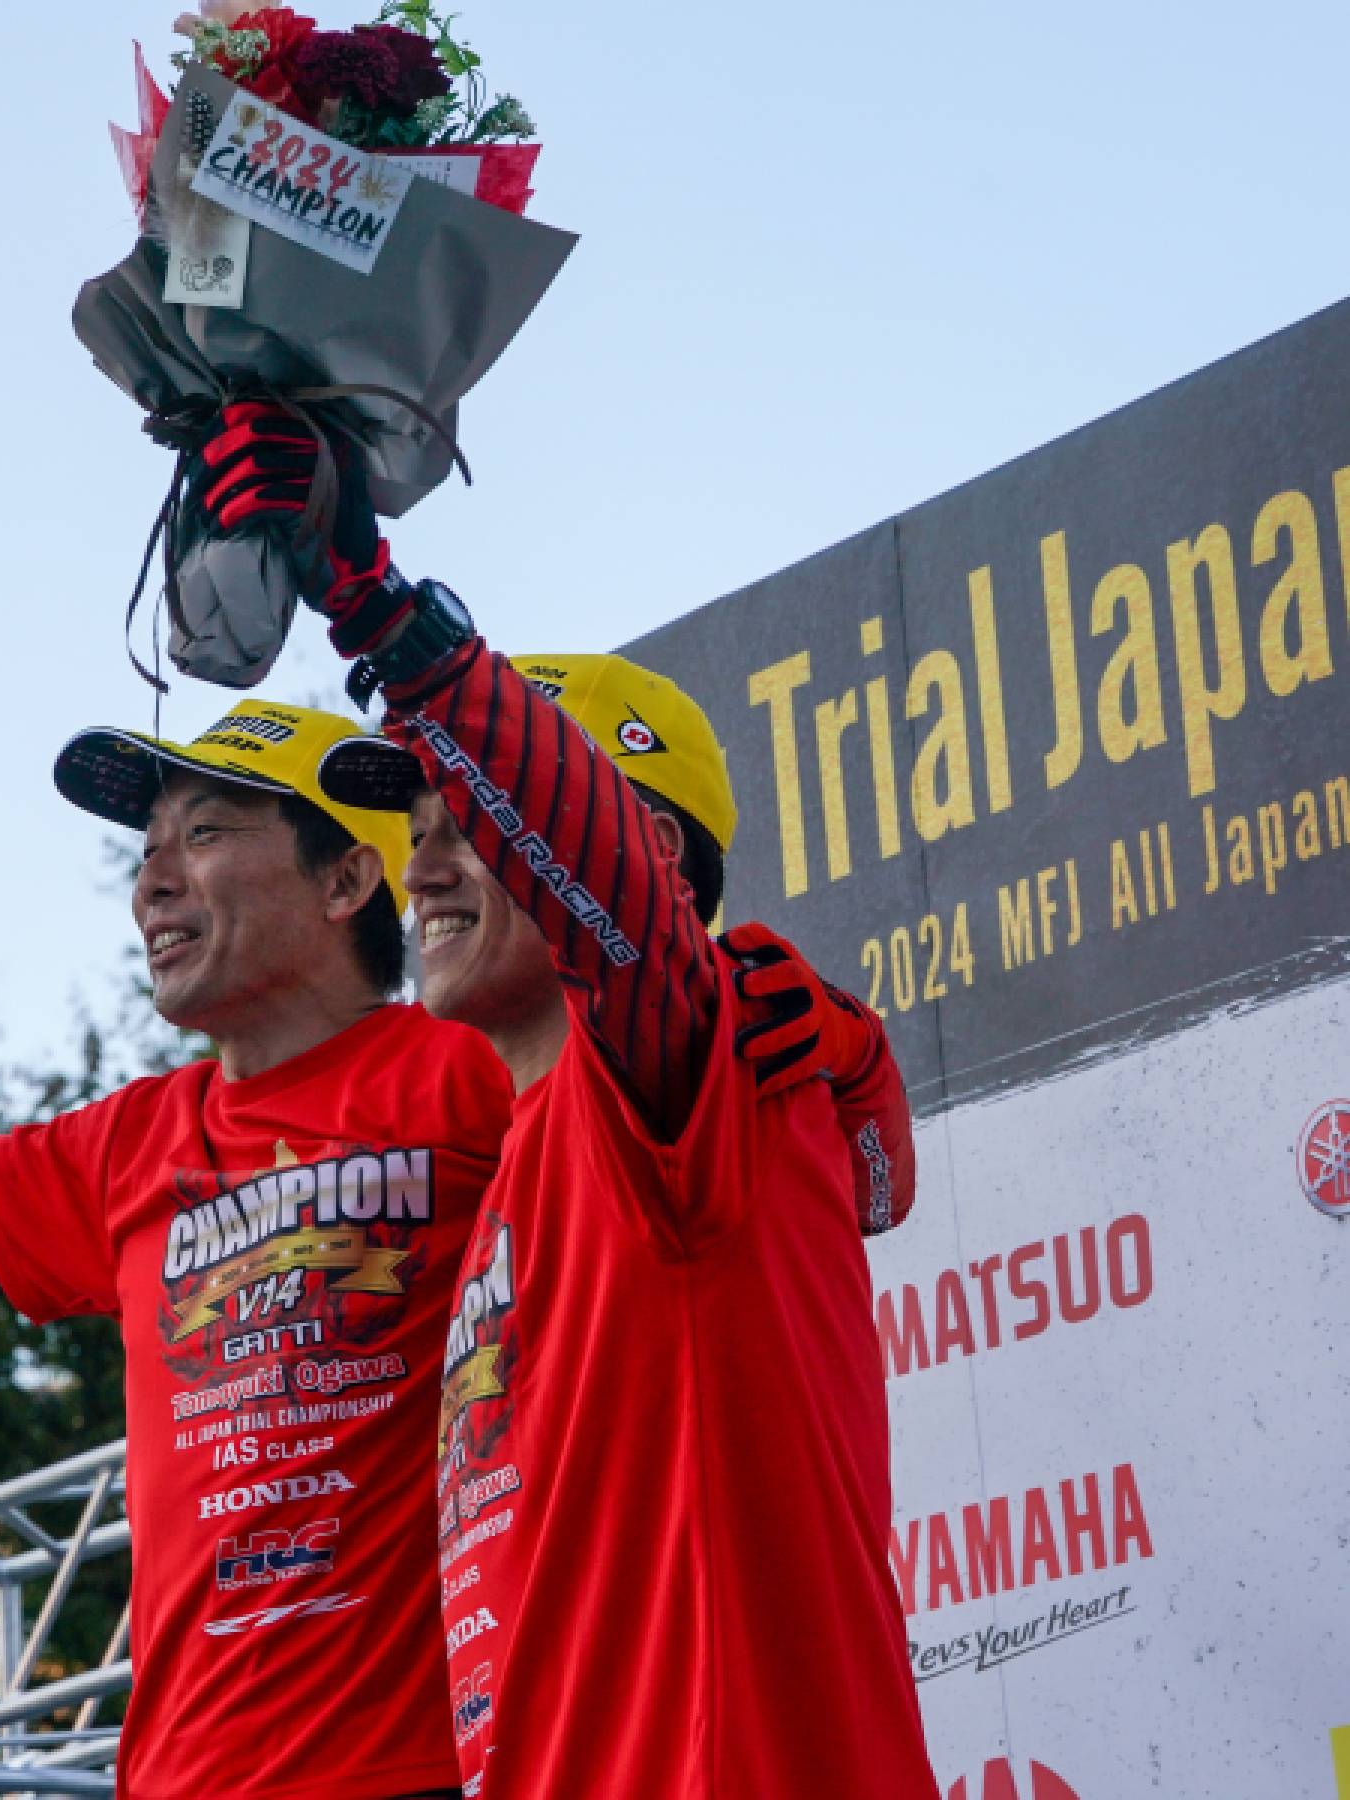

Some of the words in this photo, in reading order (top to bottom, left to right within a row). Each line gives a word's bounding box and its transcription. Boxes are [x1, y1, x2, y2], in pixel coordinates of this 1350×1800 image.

[209, 146, 387, 241] CHAMPION
[249, 119, 361, 205] 2024
[747, 563, 1015, 900] Trial
[1040, 464, 1350, 798] Japa
[511, 830, 641, 967] RACING
[859, 902, 976, 1019] 2024
[998, 859, 1083, 970] MFJ
[1110, 821, 1177, 931] All
[1203, 776, 1350, 895] Japan
[162, 1147, 433, 1283] CHAMPION
[237, 1267, 305, 1322] V14
[874, 1213, 1154, 1380] MATSUO
[223, 1319, 323, 1363] GATTI
[296, 1351, 409, 1395] Ogawa
[277, 1390, 395, 1428] CHAMPIONSHIP
[198, 1469, 357, 1520] HONDA
[212, 1435, 260, 1471] IAS
[265, 1435, 335, 1462] CLASS
[216, 1517, 340, 1584] HRC
[889, 1463, 1155, 1616] YAMAHA
[974, 1615, 1045, 1674] Your
[1046, 1586, 1132, 1636] Heart
